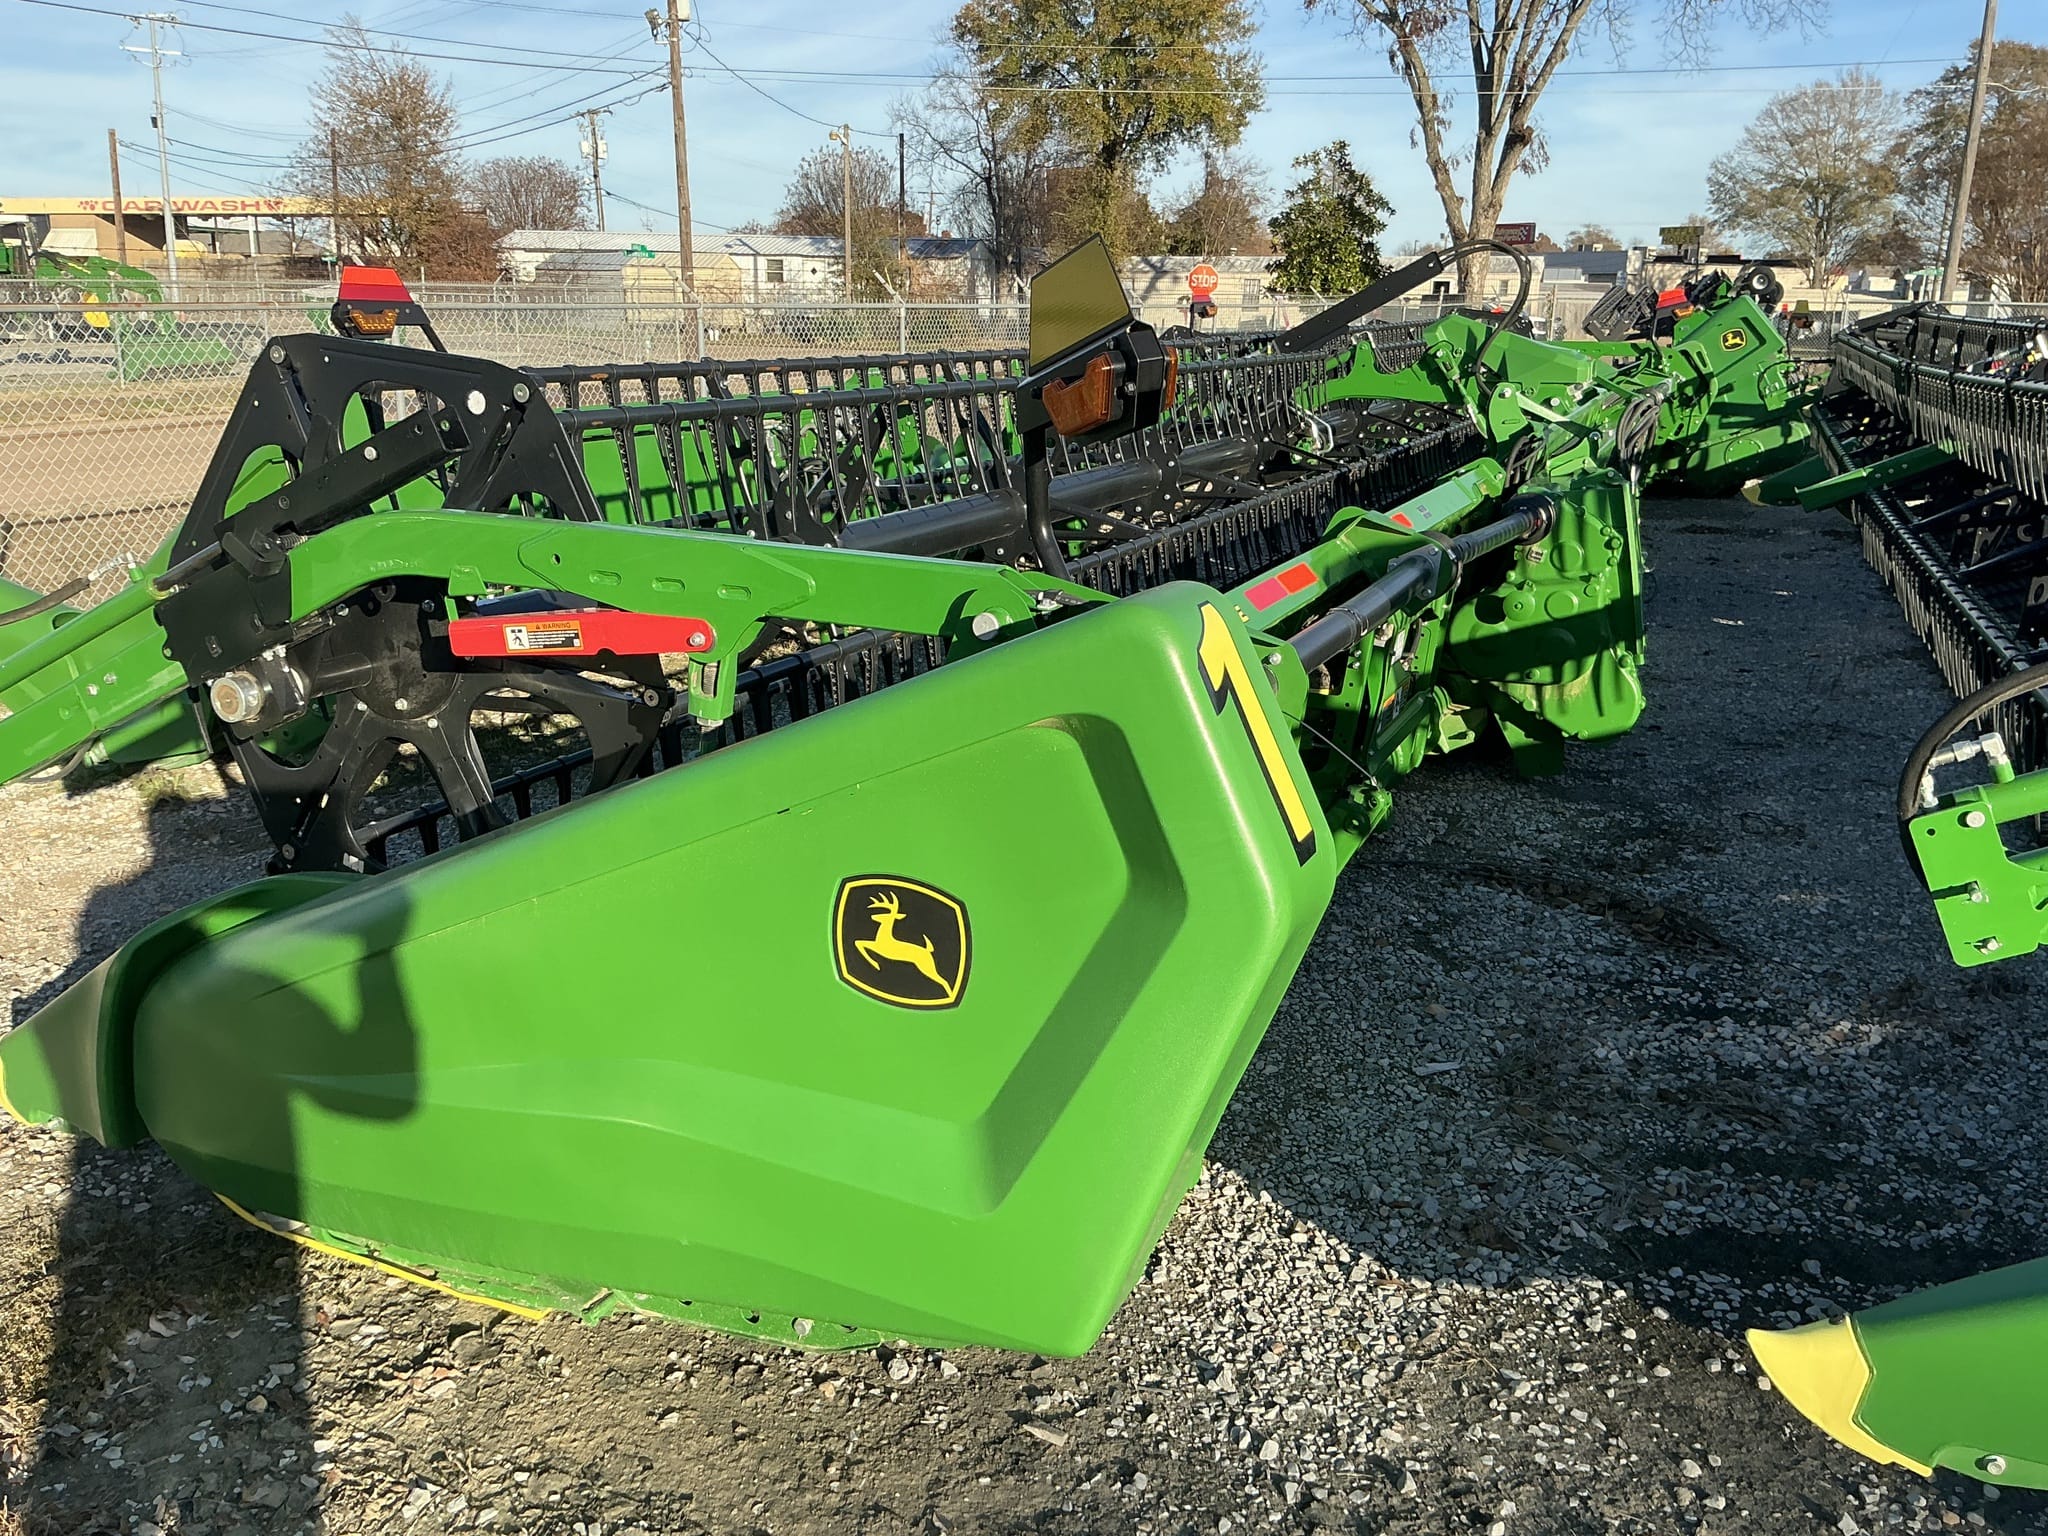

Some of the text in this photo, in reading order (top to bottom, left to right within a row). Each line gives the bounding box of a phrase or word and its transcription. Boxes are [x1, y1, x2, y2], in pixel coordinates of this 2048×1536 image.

[102, 200, 260, 211] CAR WASH
[1191, 274, 1217, 287] STOP
